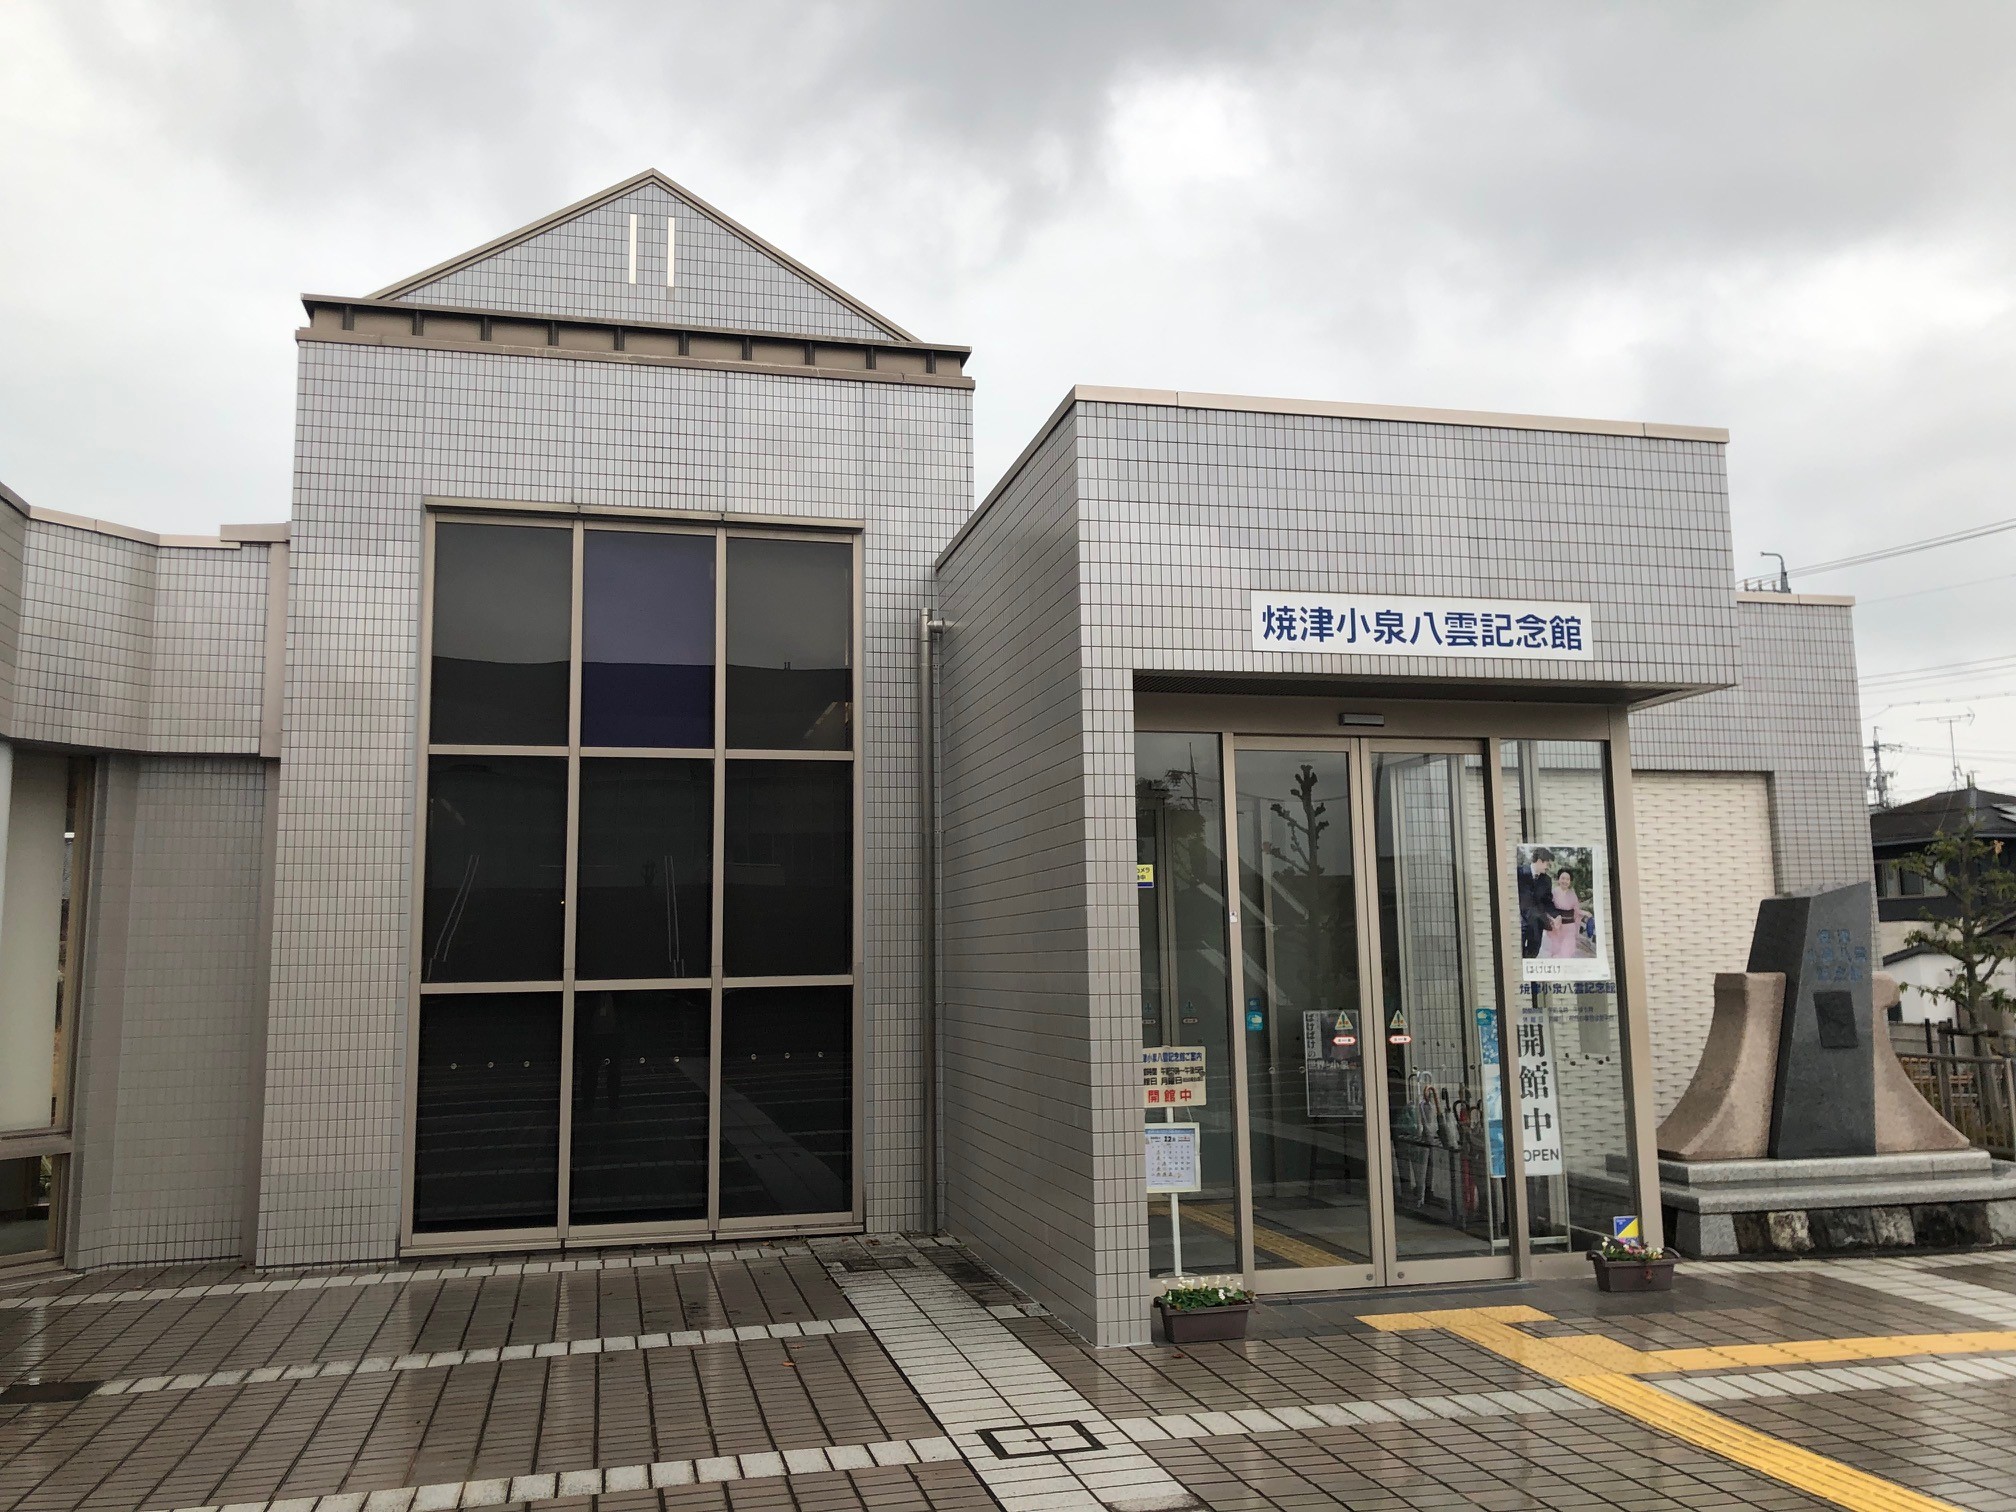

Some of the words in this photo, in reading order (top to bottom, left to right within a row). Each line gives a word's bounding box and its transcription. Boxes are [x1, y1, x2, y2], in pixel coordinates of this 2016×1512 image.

[1262, 604, 1583, 651] 焼津小泉八雲記念館
[1147, 1088, 1192, 1104] 開館中
[1516, 1023, 1552, 1142] 開館中
[1524, 1148, 1560, 1162] OPEN
